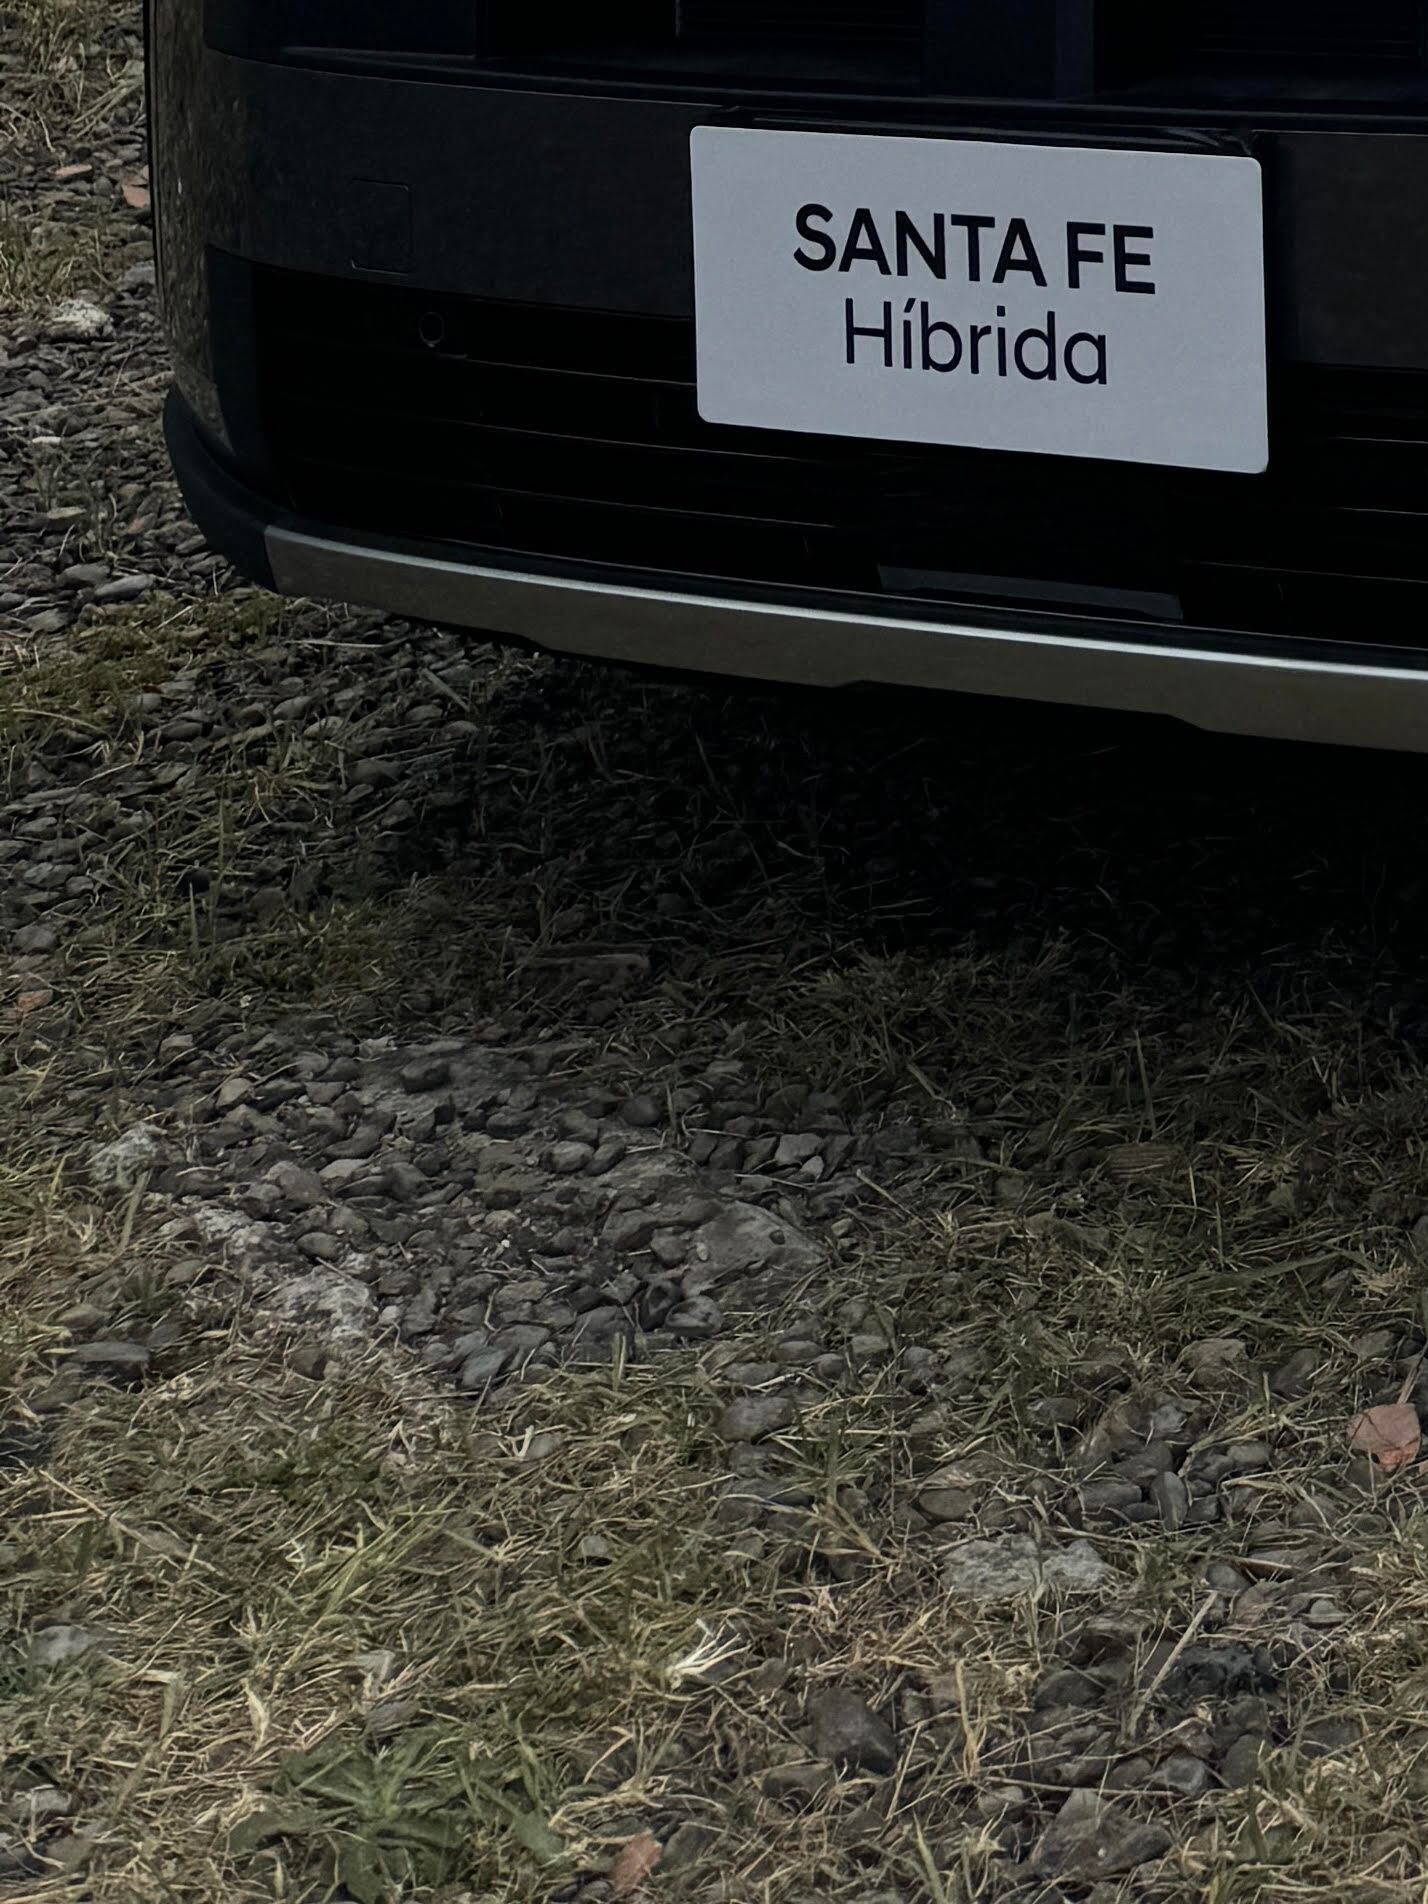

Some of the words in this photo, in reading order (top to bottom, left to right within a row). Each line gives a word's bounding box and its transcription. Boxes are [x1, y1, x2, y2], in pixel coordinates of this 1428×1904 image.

[793, 203, 1048, 288] SANTA
[1066, 221, 1156, 295] FE
[845, 297, 1108, 385] Híbrida
